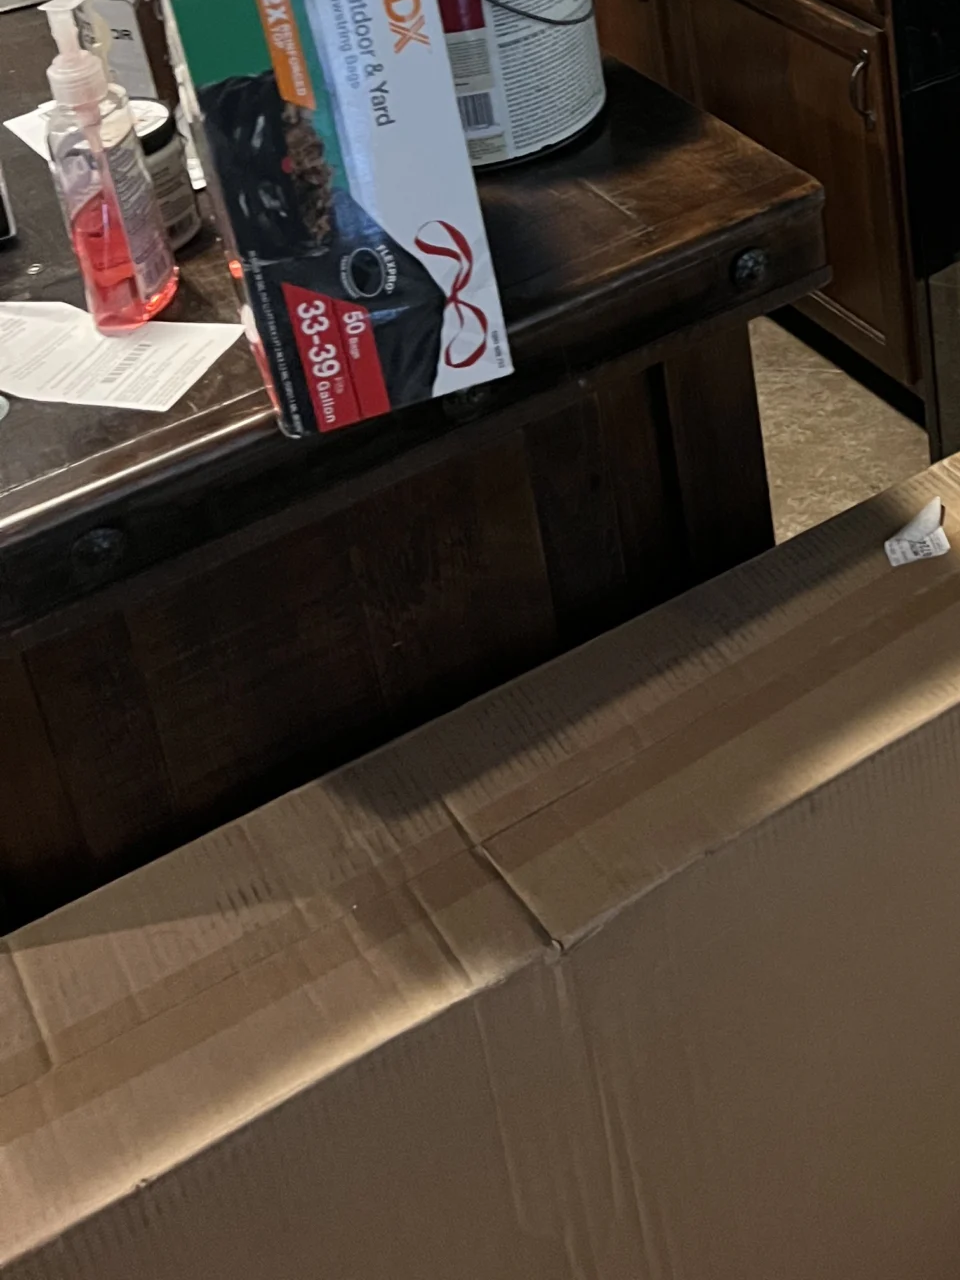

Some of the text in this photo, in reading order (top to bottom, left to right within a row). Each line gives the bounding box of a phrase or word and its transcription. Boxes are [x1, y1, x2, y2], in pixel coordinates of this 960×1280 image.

[279, 23, 307, 97] REINFORCED
[363, 63, 384, 79] &
[369, 80, 396, 127] Yard
[375, 244, 398, 291] FLEXPRO
[296, 300, 341, 378] 33-39
[342, 311, 366, 335] 50
[316, 381, 336, 424] Gallon
